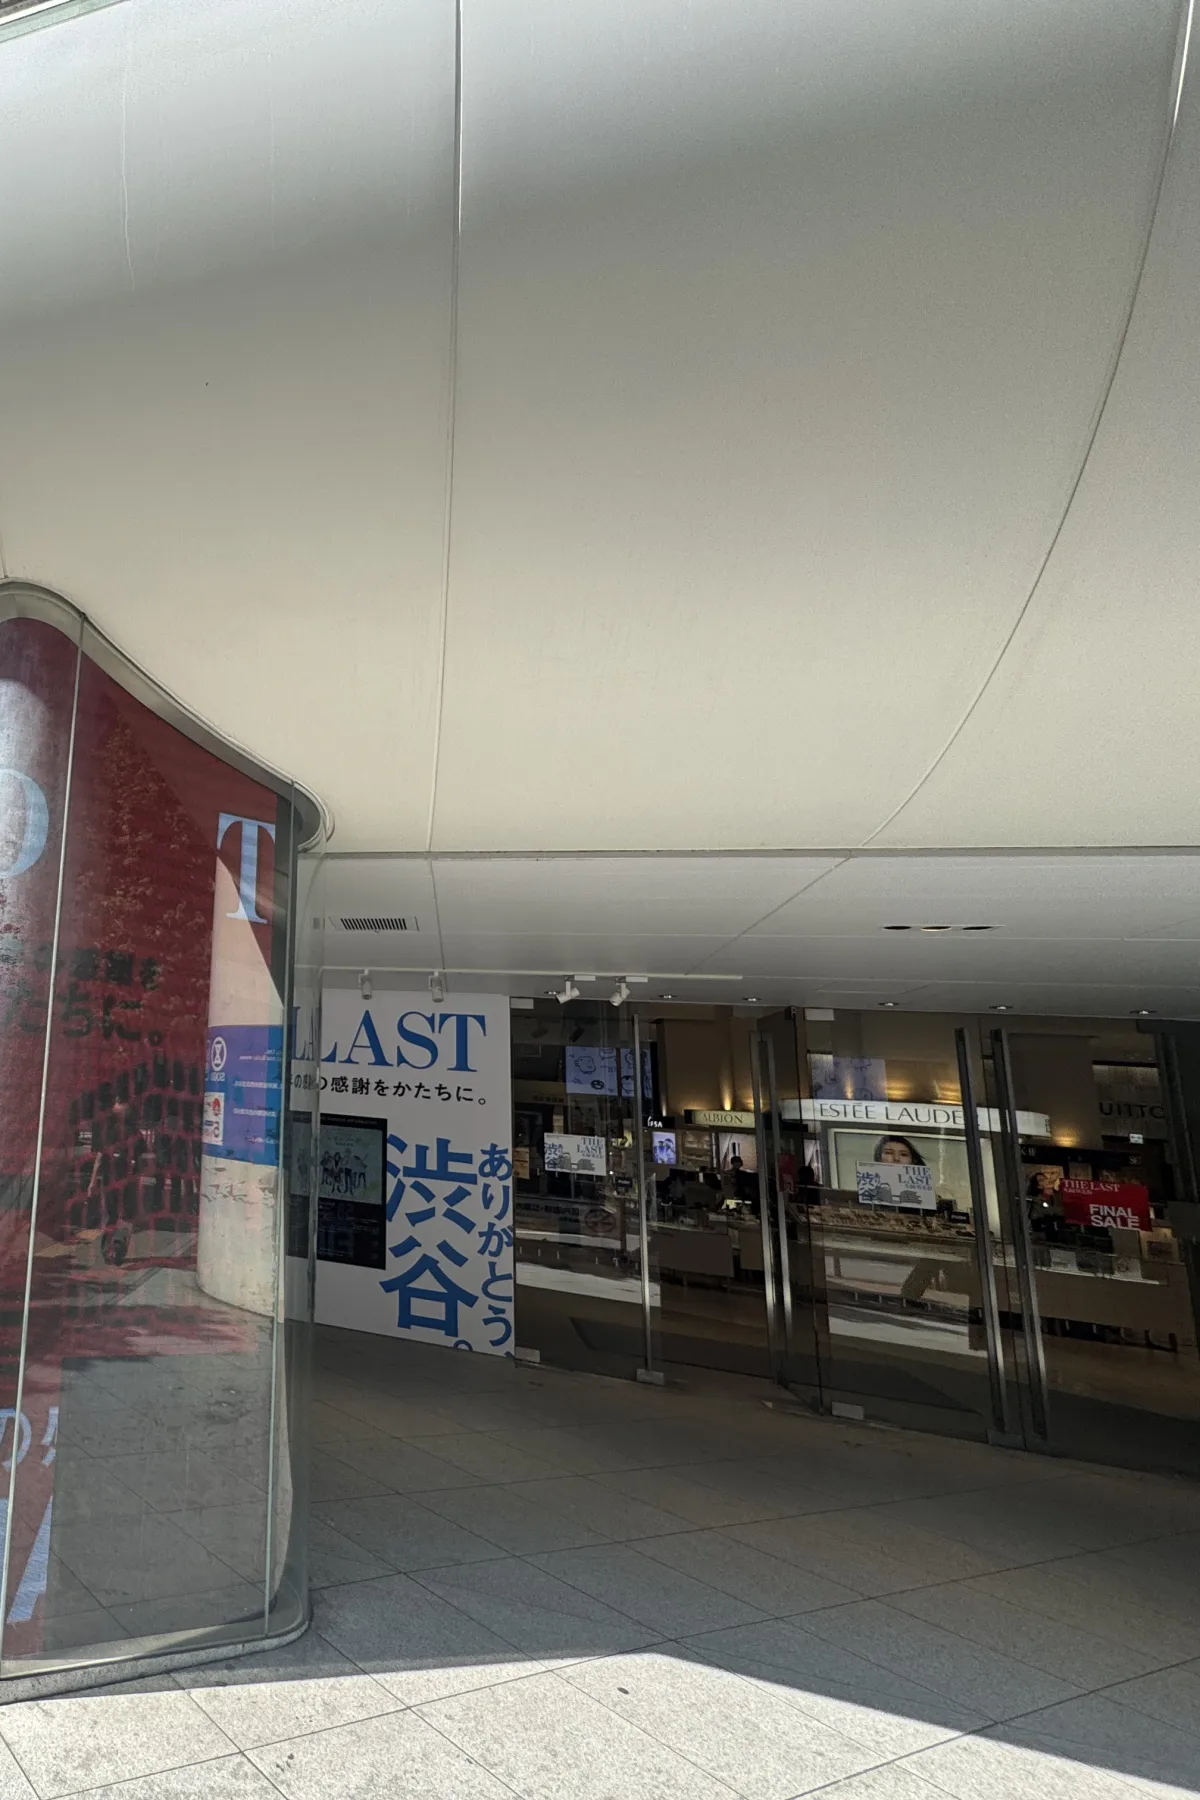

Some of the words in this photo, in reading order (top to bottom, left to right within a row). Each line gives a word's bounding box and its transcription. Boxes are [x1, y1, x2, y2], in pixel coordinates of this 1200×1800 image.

[702, 1112, 743, 1125] ALBION
[819, 1103, 876, 1120] ESTÉE
[885, 1106, 966, 1126] LAUDE
[1063, 1179, 1089, 1189] THE
[1090, 1181, 1121, 1193] LAST
[1089, 1203, 1139, 1219] FINAL
[1090, 1214, 1141, 1230] SALE
